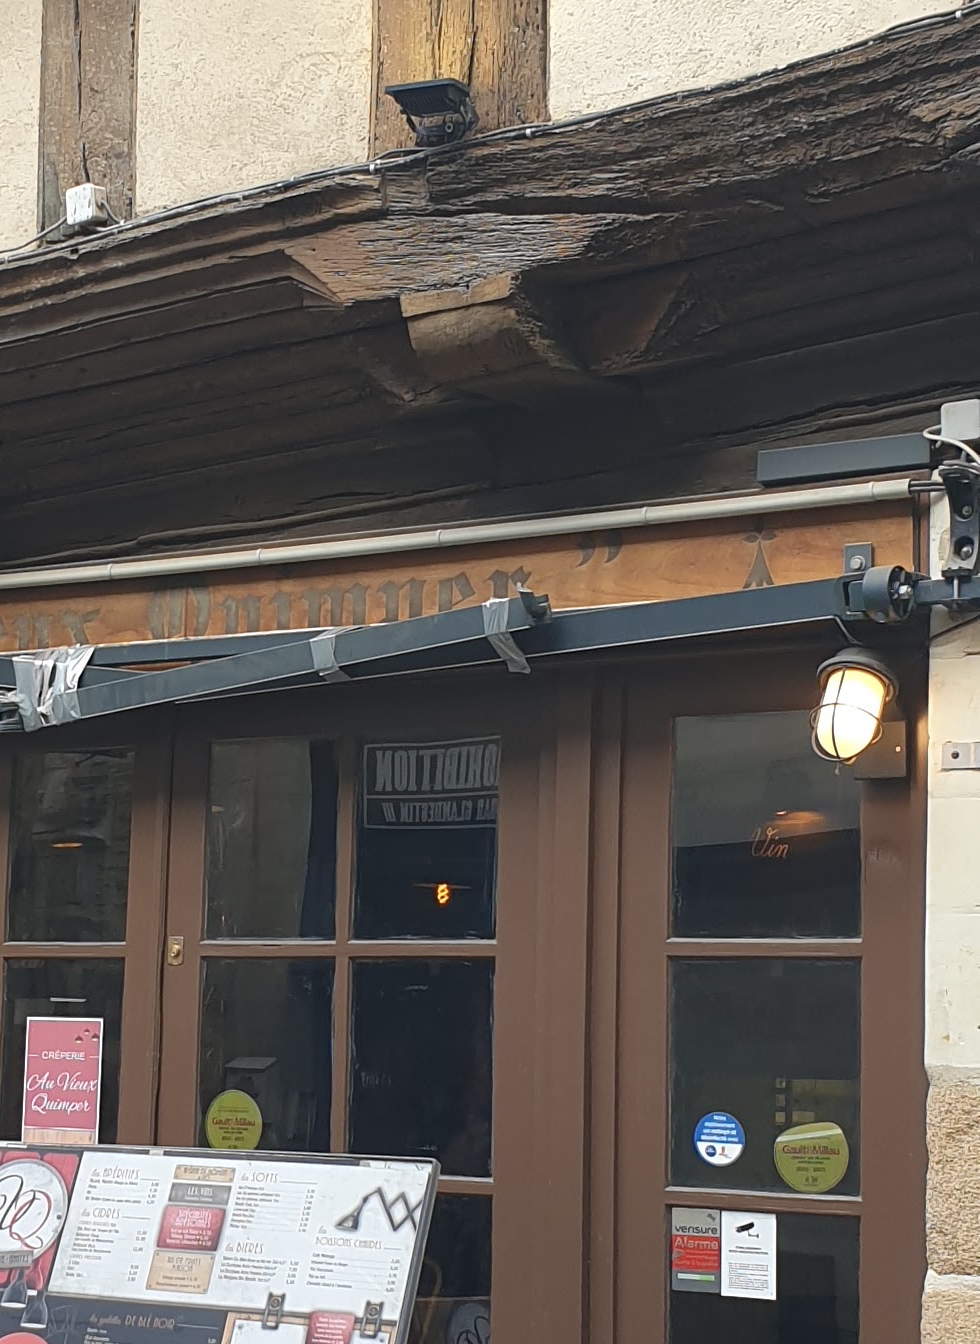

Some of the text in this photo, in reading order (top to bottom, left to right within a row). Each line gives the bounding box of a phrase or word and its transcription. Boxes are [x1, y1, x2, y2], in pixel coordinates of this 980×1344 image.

[750, 827, 790, 859] Vin
[27, 1071, 98, 1093] Au Vieux
[30, 1093, 91, 1116] Quimper
[250, 1172, 278, 1182] SOFTS
[91, 1207, 121, 1219] CIDRES
[674, 1236, 719, 1250] Alarme
[124, 1315, 136, 1326] DE
[137, 1312, 152, 1328] BLÉ
